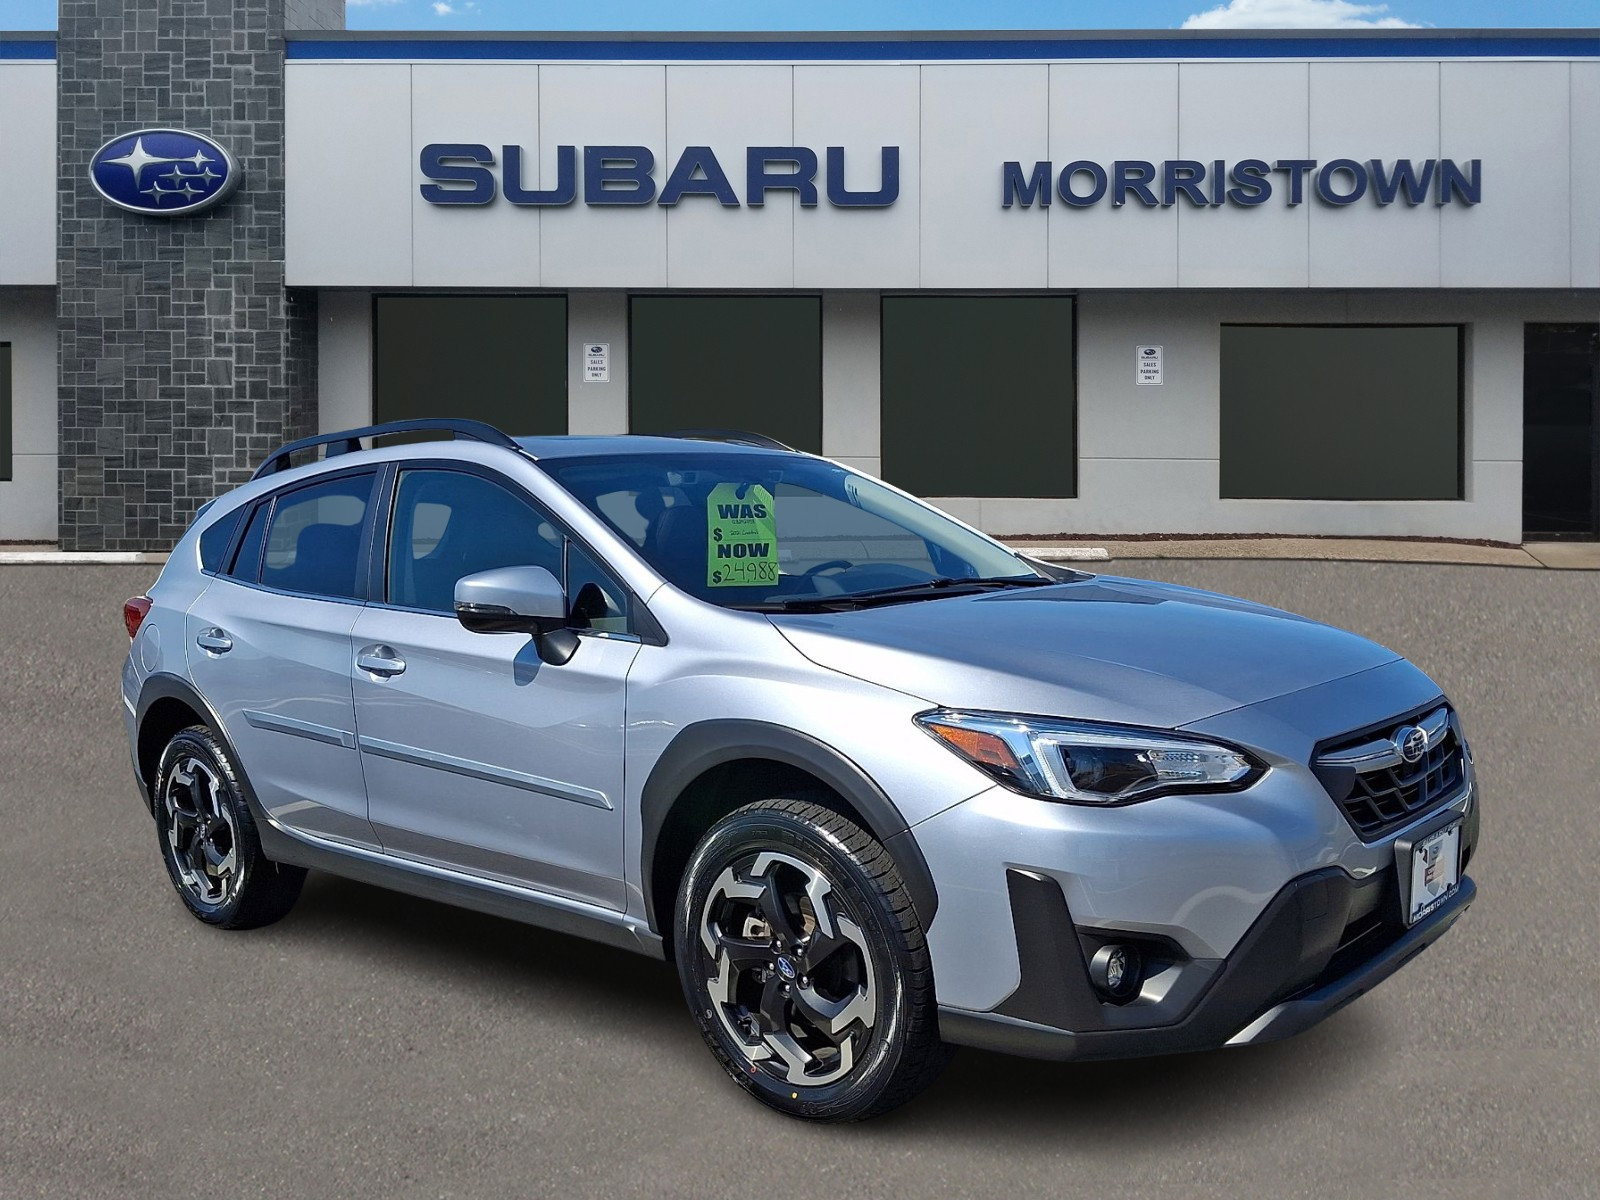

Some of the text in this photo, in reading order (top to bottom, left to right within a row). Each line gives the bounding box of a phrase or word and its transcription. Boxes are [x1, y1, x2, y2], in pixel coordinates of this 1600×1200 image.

[419, 143, 900, 207] SUBARU
[1001, 158, 1482, 208] MORRISTOWN
[717, 504, 767, 519] WAS
[713, 527, 723, 542] $
[717, 543, 770, 558] NOW
